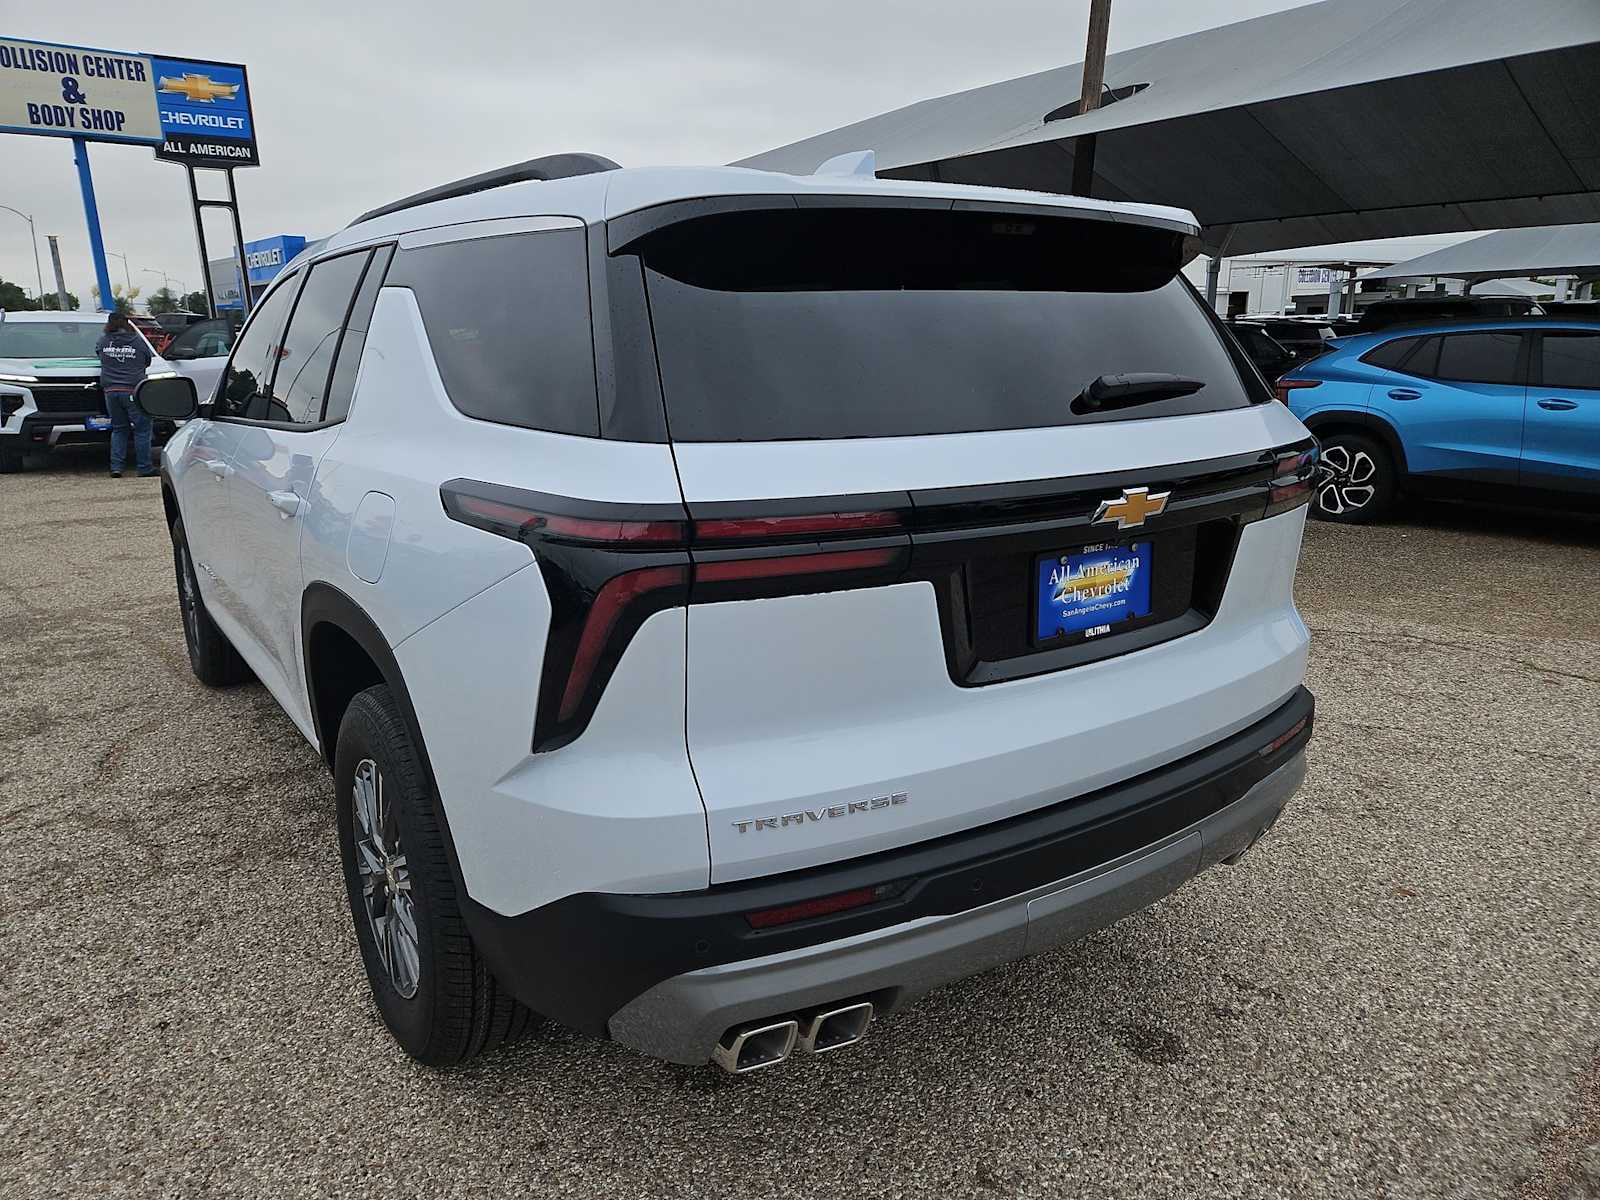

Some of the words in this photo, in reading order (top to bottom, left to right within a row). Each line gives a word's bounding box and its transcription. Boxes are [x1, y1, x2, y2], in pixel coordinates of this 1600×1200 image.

[0, 45, 80, 75] OLLISION
[83, 54, 146, 82] CENTER
[62, 76, 87, 104] &
[27, 102, 75, 126] BODY
[79, 107, 126, 132] SHOP
[160, 111, 245, 129] CHEVROLET
[163, 141, 187, 154] ALL
[189, 143, 251, 158] AMERICAN
[1083, 543, 1104, 554] SINCE
[1048, 565, 1071, 585] All
[1076, 556, 1140, 579] American
[1061, 577, 1130, 604] Chevrolet
[1062, 599, 1126, 618] SanAngeloChevy.com
[732, 791, 909, 834] TRAVERSE
